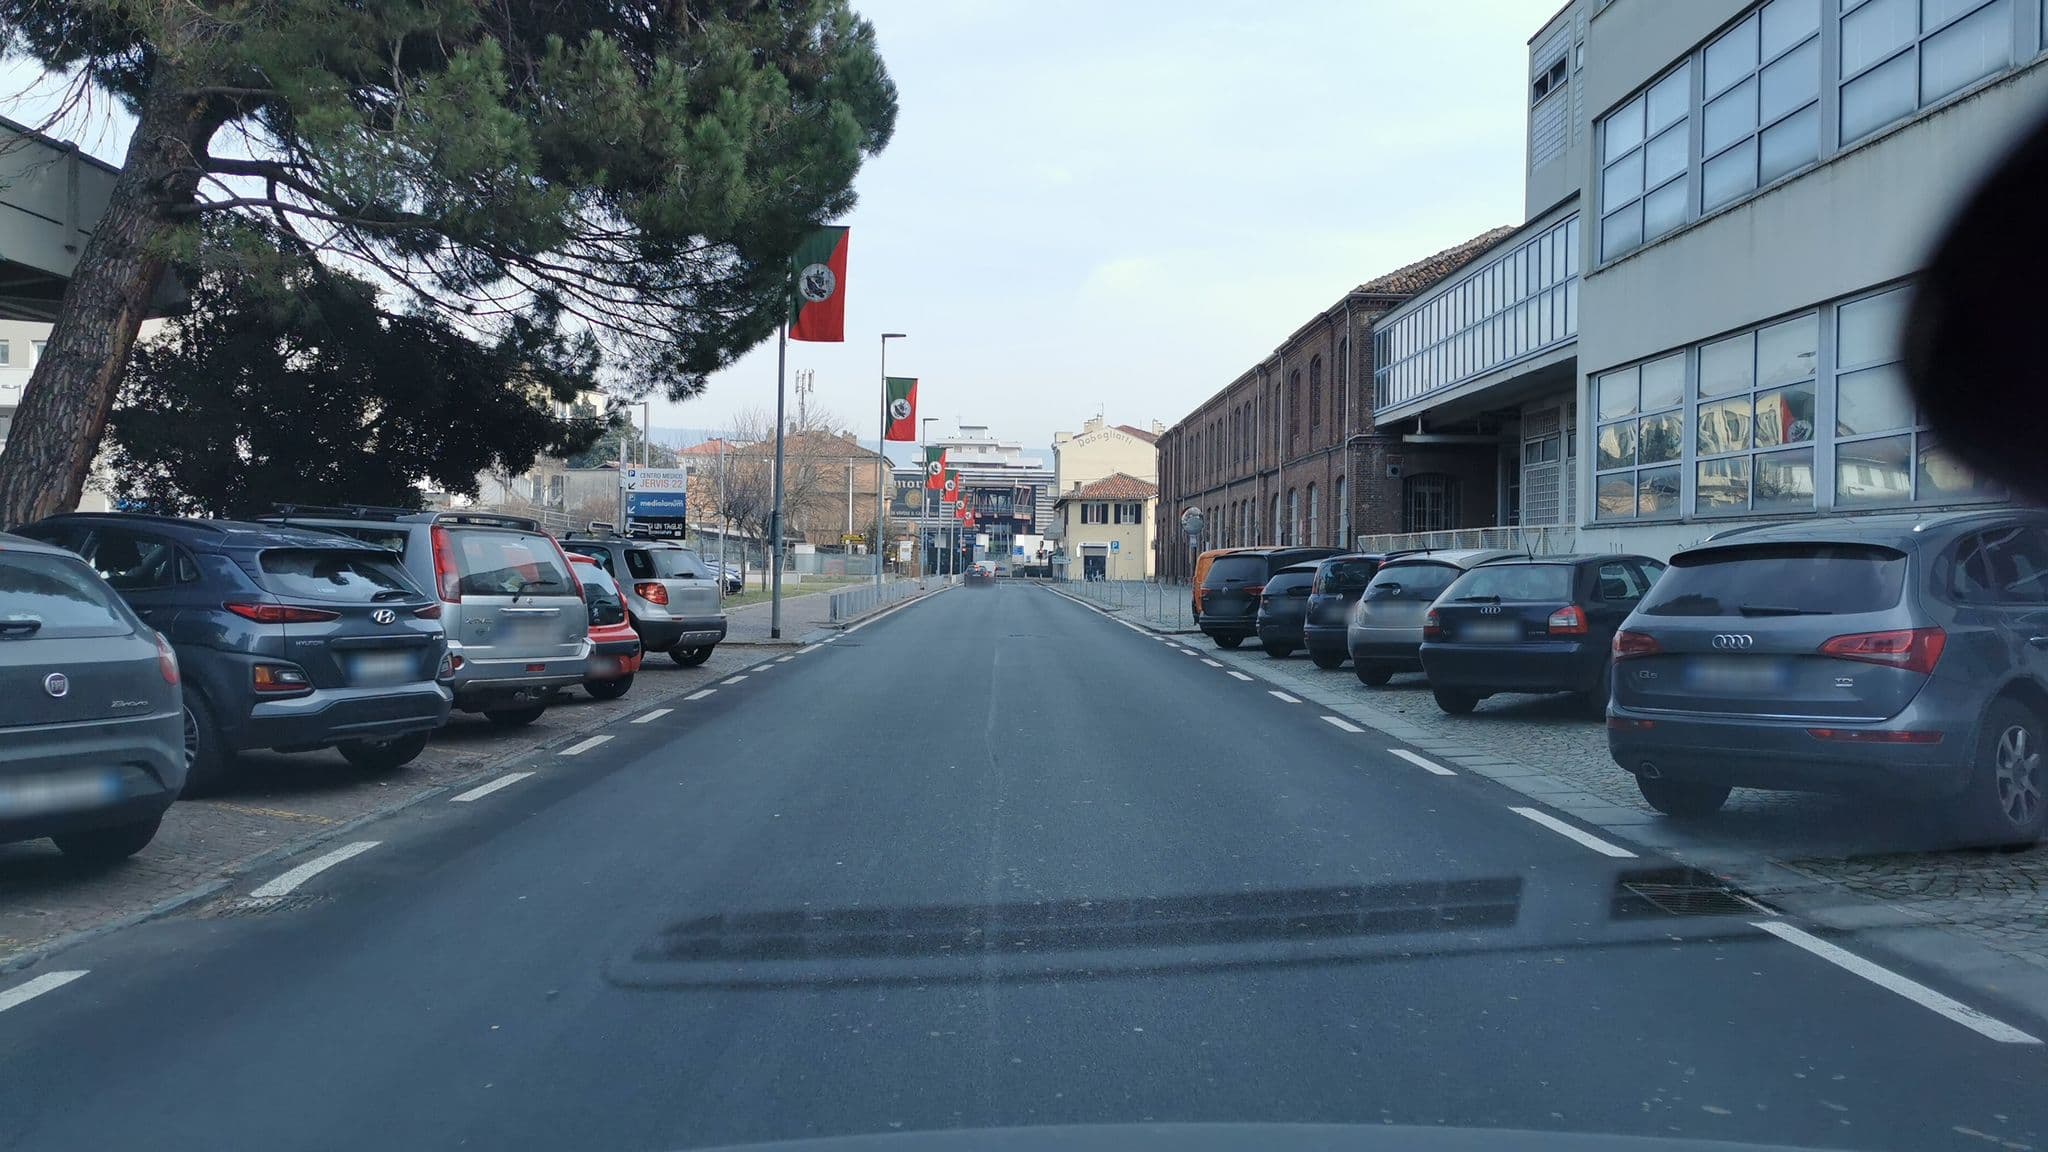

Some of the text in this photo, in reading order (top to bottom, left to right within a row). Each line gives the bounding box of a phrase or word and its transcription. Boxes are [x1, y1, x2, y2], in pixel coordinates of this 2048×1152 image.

[640, 479, 683, 488] JERVIS 22
[640, 499, 683, 507] mediolanum
